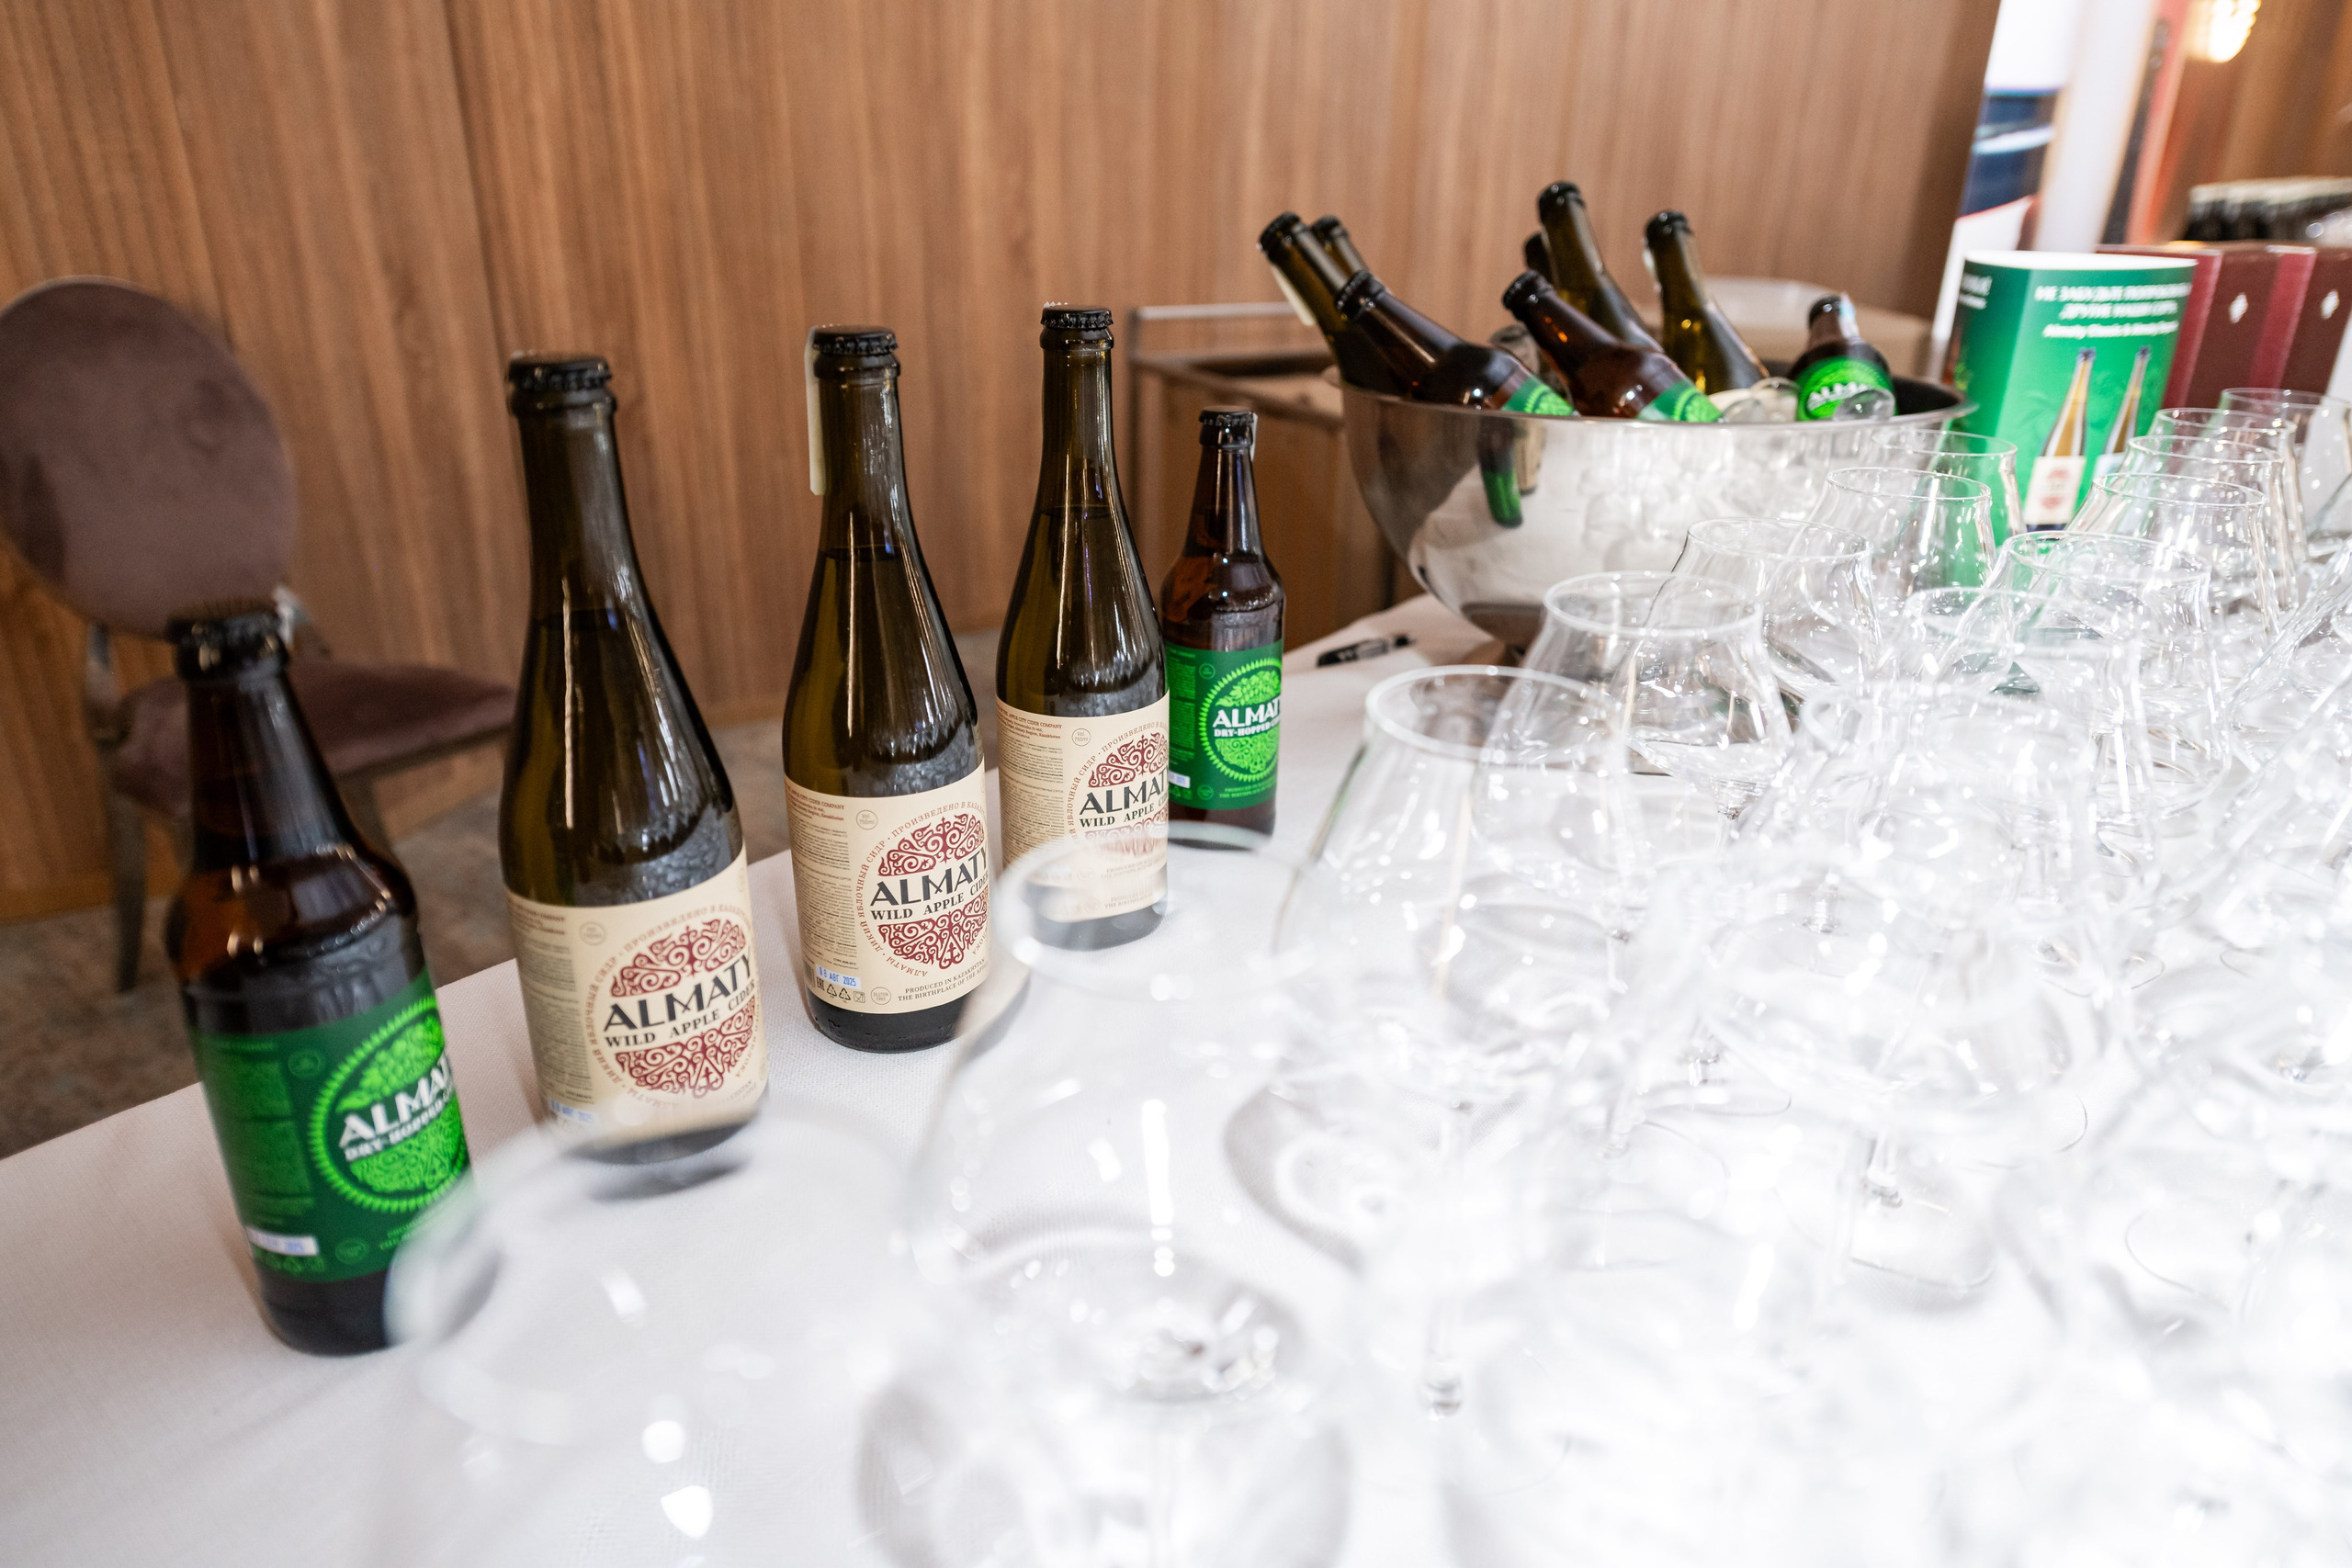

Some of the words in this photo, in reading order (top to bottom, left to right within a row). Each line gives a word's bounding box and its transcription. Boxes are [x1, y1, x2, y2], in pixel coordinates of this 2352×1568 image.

[1079, 755, 1096, 776] СИДР
[821, 801, 844, 810] COMPANY
[1080, 816, 1115, 828] WILD
[1124, 804, 1154, 822] APPLE
[892, 802, 959, 837] ПРОИЗВЕДЕНО
[866, 840, 886, 863] СИДР
[870, 841, 987, 906] ALMATY
[856, 864, 869, 919] ЯБЛОЧНЫЙ
[871, 908, 913, 920] WILD
[923, 893, 964, 915] APPLE
[860, 920, 884, 953] ДИКИЙ
[594, 957, 618, 983] СИДР
[886, 956, 928, 977] АЛМАТЫ
[905, 981, 944, 994] PRODUCED
[953, 957, 985, 982] KAZAKHSTAN
[604, 944, 750, 1032] ALMATY
[842, 976, 856, 987] 2025
[915, 982, 956, 999] BIRTHPLACE
[604, 1032, 656, 1048] WILD
[670, 1009, 720, 1038] APPLE
[728, 979, 754, 1011] CIDER
